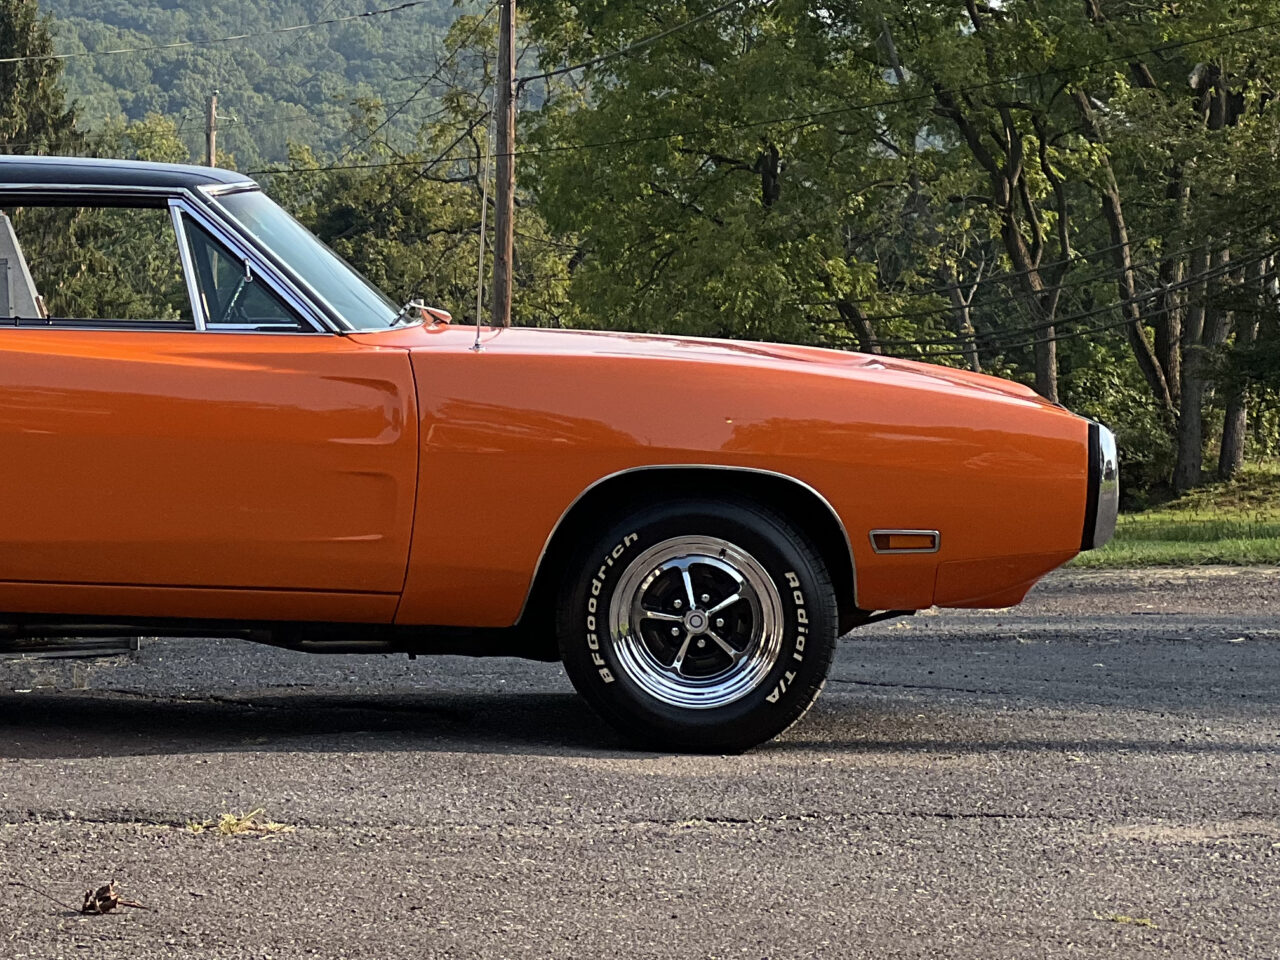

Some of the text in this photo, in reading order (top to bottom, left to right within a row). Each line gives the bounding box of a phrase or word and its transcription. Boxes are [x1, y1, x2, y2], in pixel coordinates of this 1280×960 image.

[586, 531, 638, 683] BFGoodrich
[765, 570, 809, 703] Radial T/A
